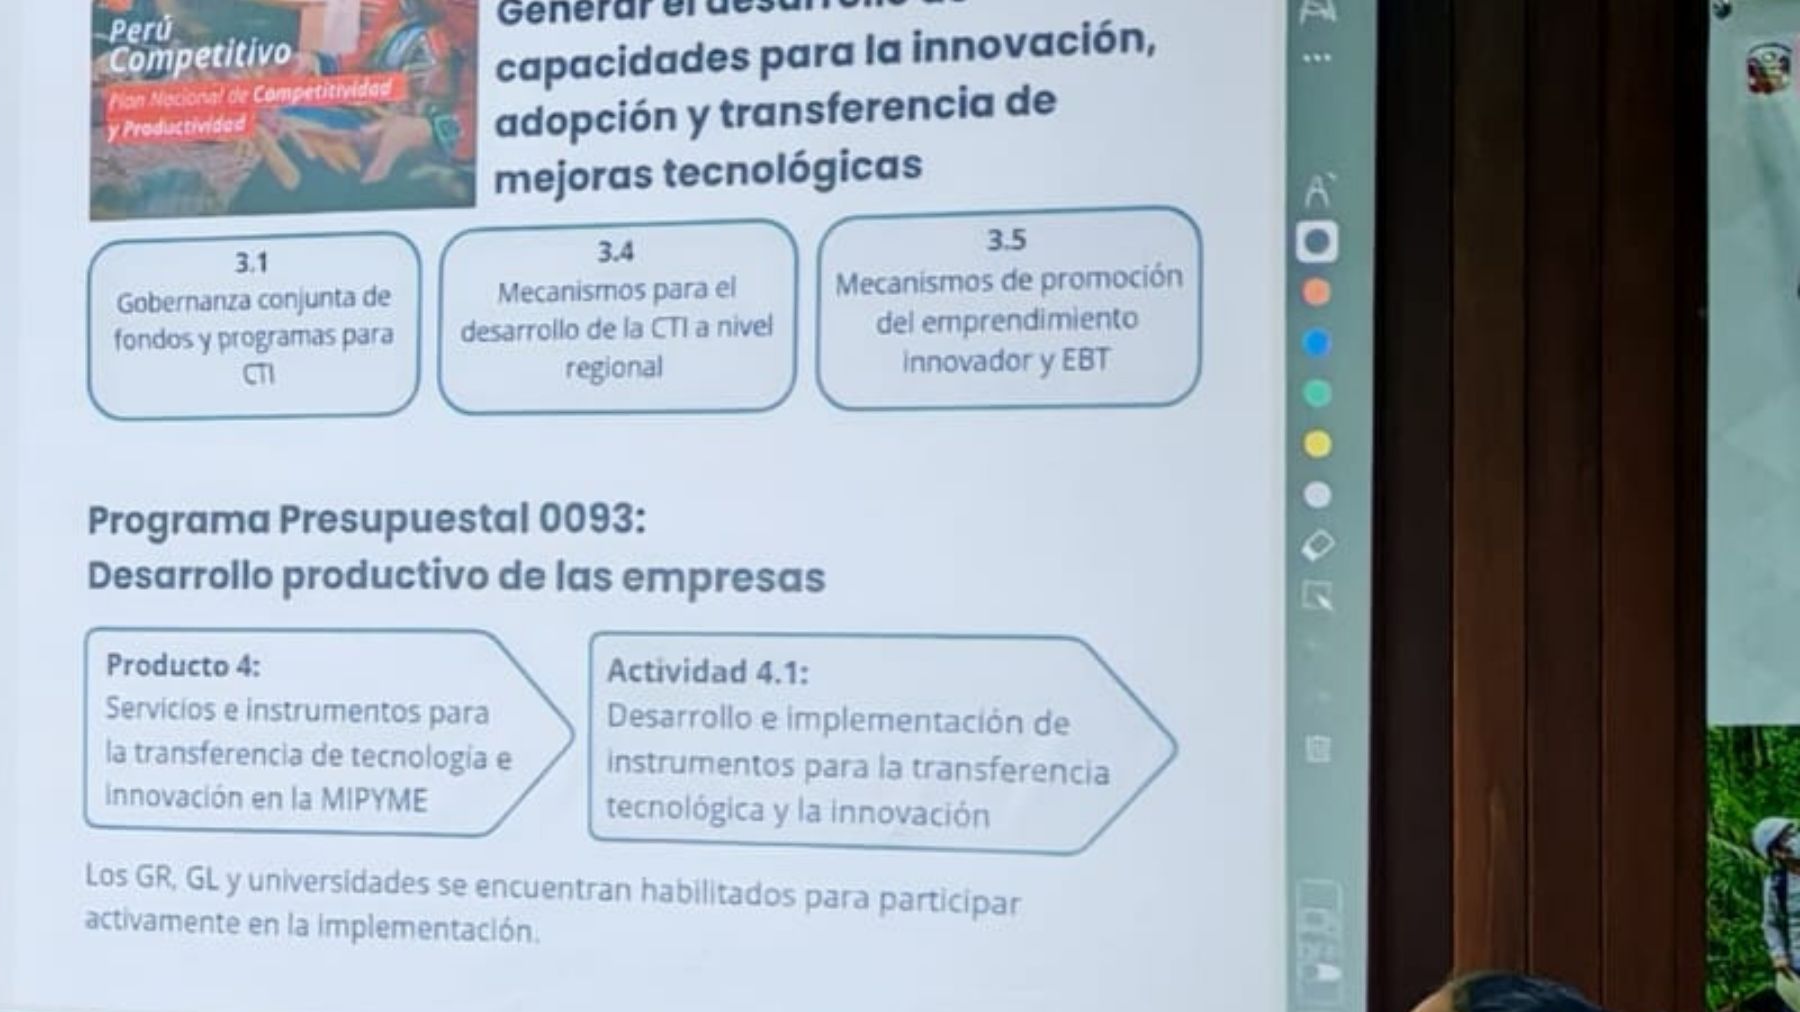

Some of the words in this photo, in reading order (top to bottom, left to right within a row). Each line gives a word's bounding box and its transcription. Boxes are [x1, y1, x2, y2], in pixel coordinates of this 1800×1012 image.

[496, 0, 653, 26] Generar
[109, 15, 172, 43] Perú
[110, 38, 292, 78] Competitivo
[495, 41, 751, 92] capacidades
[760, 41, 855, 82] para
[865, 33, 902, 66] la
[912, 19, 1156, 64] innovación,
[253, 79, 393, 104] Competitividad
[122, 115, 247, 138] Productividad
[494, 98, 677, 146] adopción
[719, 84, 995, 129] transferencia
[1005, 83, 1057, 117] de
[494, 158, 654, 203] mejoras
[662, 147, 923, 194] tecnológicas
[597, 240, 635, 264] 3.4
[987, 227, 1027, 252] 3.5
[235, 250, 267, 274] 3.1
[498, 280, 647, 305] Mecanismos
[652, 281, 709, 307] para
[836, 271, 995, 297] Mecanismos
[1000, 267, 1034, 292] de
[1040, 261, 1184, 298] promoción
[116, 291, 252, 315] Gobernanza
[257, 287, 357, 317] conjunta
[460, 317, 580, 343] desarrollo
[586, 317, 618, 341] de
[651, 315, 689, 340] CTI
[717, 312, 774, 338] nivel
[876, 309, 915, 336] del
[921, 306, 1140, 339] emprendimiento
[113, 327, 195, 352] fondos
[217, 327, 337, 355] programas
[341, 327, 395, 353] para
[242, 361, 276, 386] CTI
[565, 354, 663, 386] regional
[903, 347, 1034, 374] innovador
[1062, 345, 1113, 372] EBT
[88, 505, 271, 545] Programa
[279, 500, 529, 544] Presupuestal
[539, 501, 646, 534] 0093:
[88, 558, 274, 590] Desarrollo
[282, 555, 490, 601] productivo
[498, 559, 546, 591] de
[555, 558, 613, 593] las
[622, 567, 826, 604] empresas
[107, 651, 230, 678] Producto
[235, 653, 261, 678] 4:
[606, 657, 748, 684] Actividad
[755, 660, 809, 685] 4.1:
[105, 694, 217, 722] Servicios
[246, 696, 422, 724] instrumentos
[429, 704, 490, 731] para
[607, 701, 753, 731] Desarrollo
[787, 705, 1025, 739] implementación
[1033, 708, 1071, 737] de
[133, 739, 303, 768] transferencia
[311, 742, 344, 768] de
[607, 750, 795, 778] instrumentos
[804, 758, 870, 785] para
[912, 754, 1111, 786] transferencia
[105, 783, 244, 810] innovación
[321, 786, 429, 814] MIPYME
[605, 793, 764, 829] tecnológica
[831, 799, 991, 829] innovación
[85, 861, 129, 888] Los
[135, 863, 177, 891] GR,
[185, 864, 220, 892] GL
[248, 868, 431, 896] universidades
[474, 878, 632, 903] encuentran
[640, 876, 797, 908] habilitados
[805, 889, 870, 915] para
[879, 887, 1022, 922] participar
[84, 909, 241, 935] activamente
[317, 912, 540, 946] implementación.
